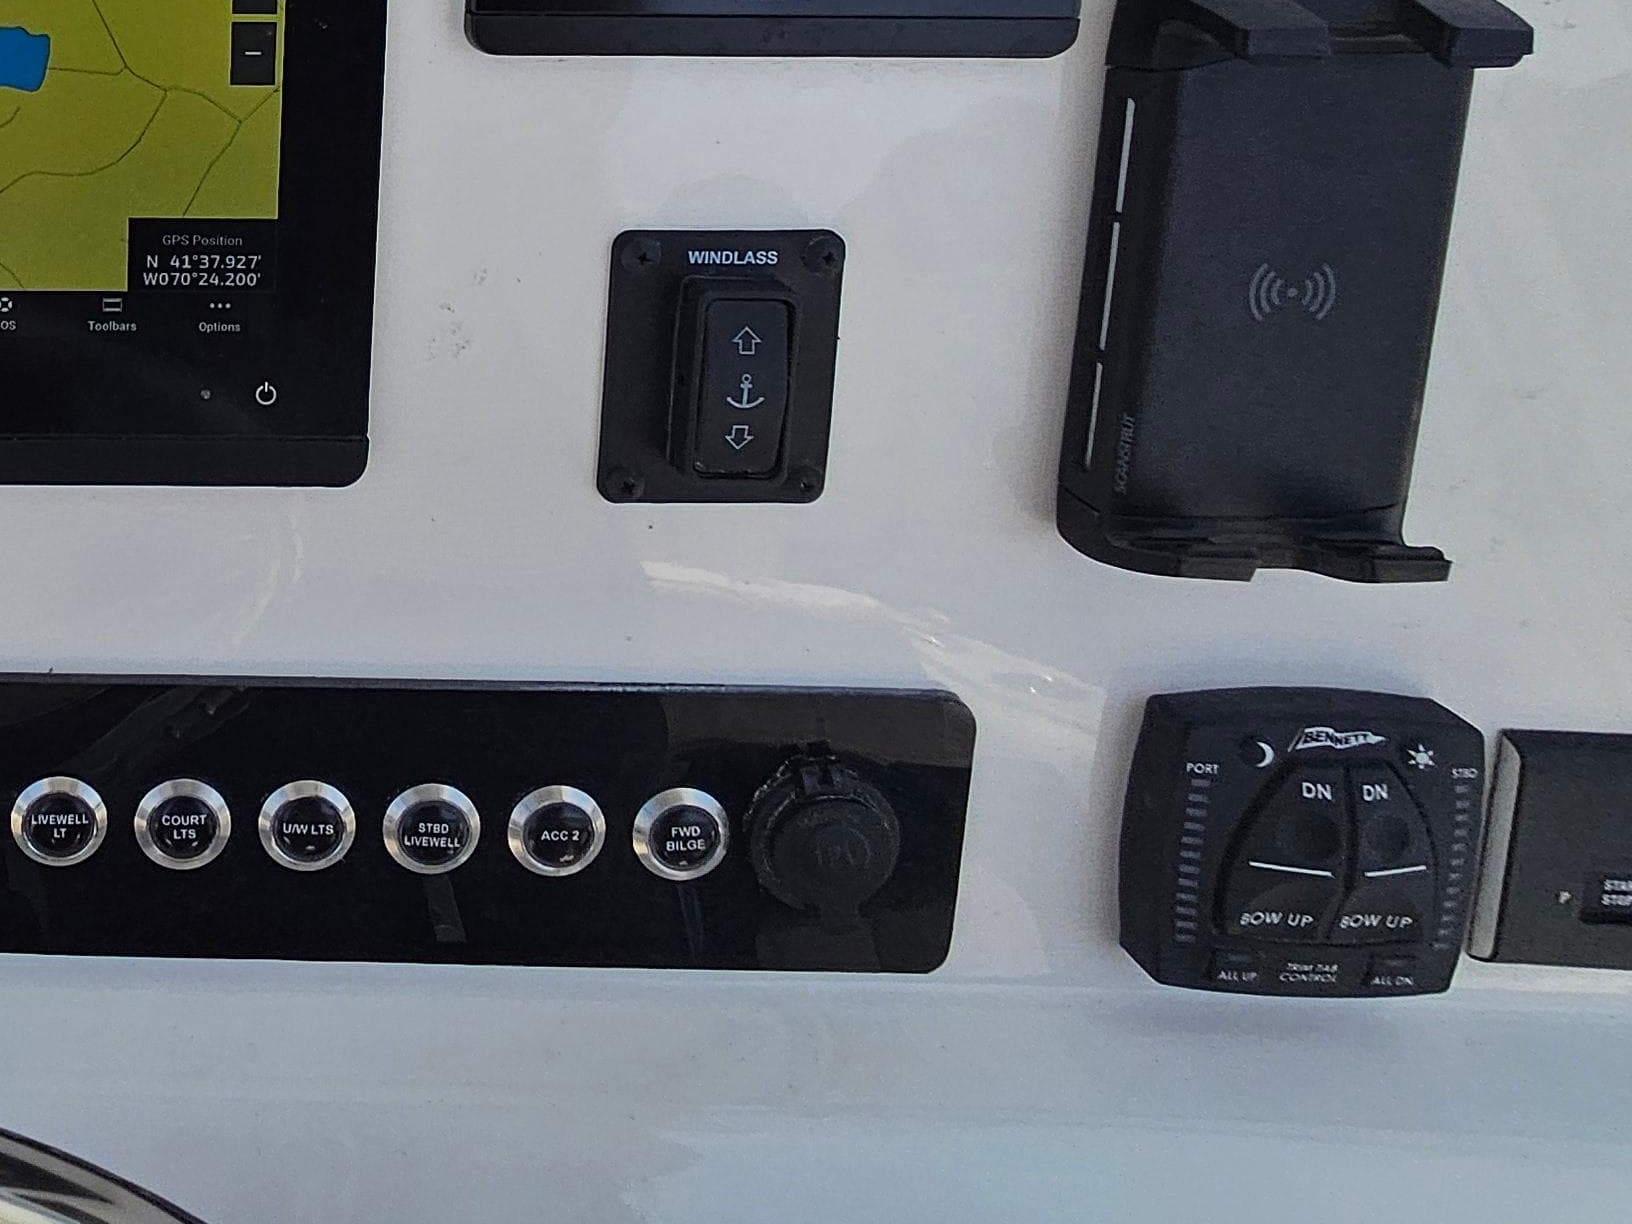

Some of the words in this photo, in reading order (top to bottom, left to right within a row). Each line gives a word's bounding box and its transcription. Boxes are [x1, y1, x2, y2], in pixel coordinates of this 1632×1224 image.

[162, 234, 189, 246] GPS
[193, 234, 243, 246] Position
[146, 254, 159, 269] N
[170, 254, 262, 269] 41°37.927'
[687, 250, 779, 265] WINDLASS
[143, 272, 262, 286] W070°24.200'
[87, 319, 138, 332] Toolbars
[198, 321, 241, 333] Options
[1302, 729, 1371, 747] BENNETT
[1186, 762, 1219, 774] PORT
[1301, 782, 1333, 801] DN
[1362, 783, 1389, 802] DN
[31, 813, 89, 826] LIVEWELL
[161, 814, 208, 827] COURT
[53, 827, 67, 839] LT
[173, 828, 197, 841] LTS
[282, 822, 309, 835] U/W
[310, 824, 335, 836] LTS
[417, 823, 450, 835] STBD
[670, 826, 701, 838] FWD
[404, 835, 461, 849] LIVEWELL
[540, 830, 569, 842] ACC
[571, 830, 580, 841] 2
[665, 839, 706, 852] BILGE
[1239, 911, 1283, 926] BOW
[1287, 912, 1314, 927] UP
[1339, 913, 1382, 929] BOW
[1385, 915, 1413, 929] UP
[1218, 970, 1239, 982] ALL
[1242, 971, 1258, 982] UP
[1372, 975, 1392, 986] ALL
